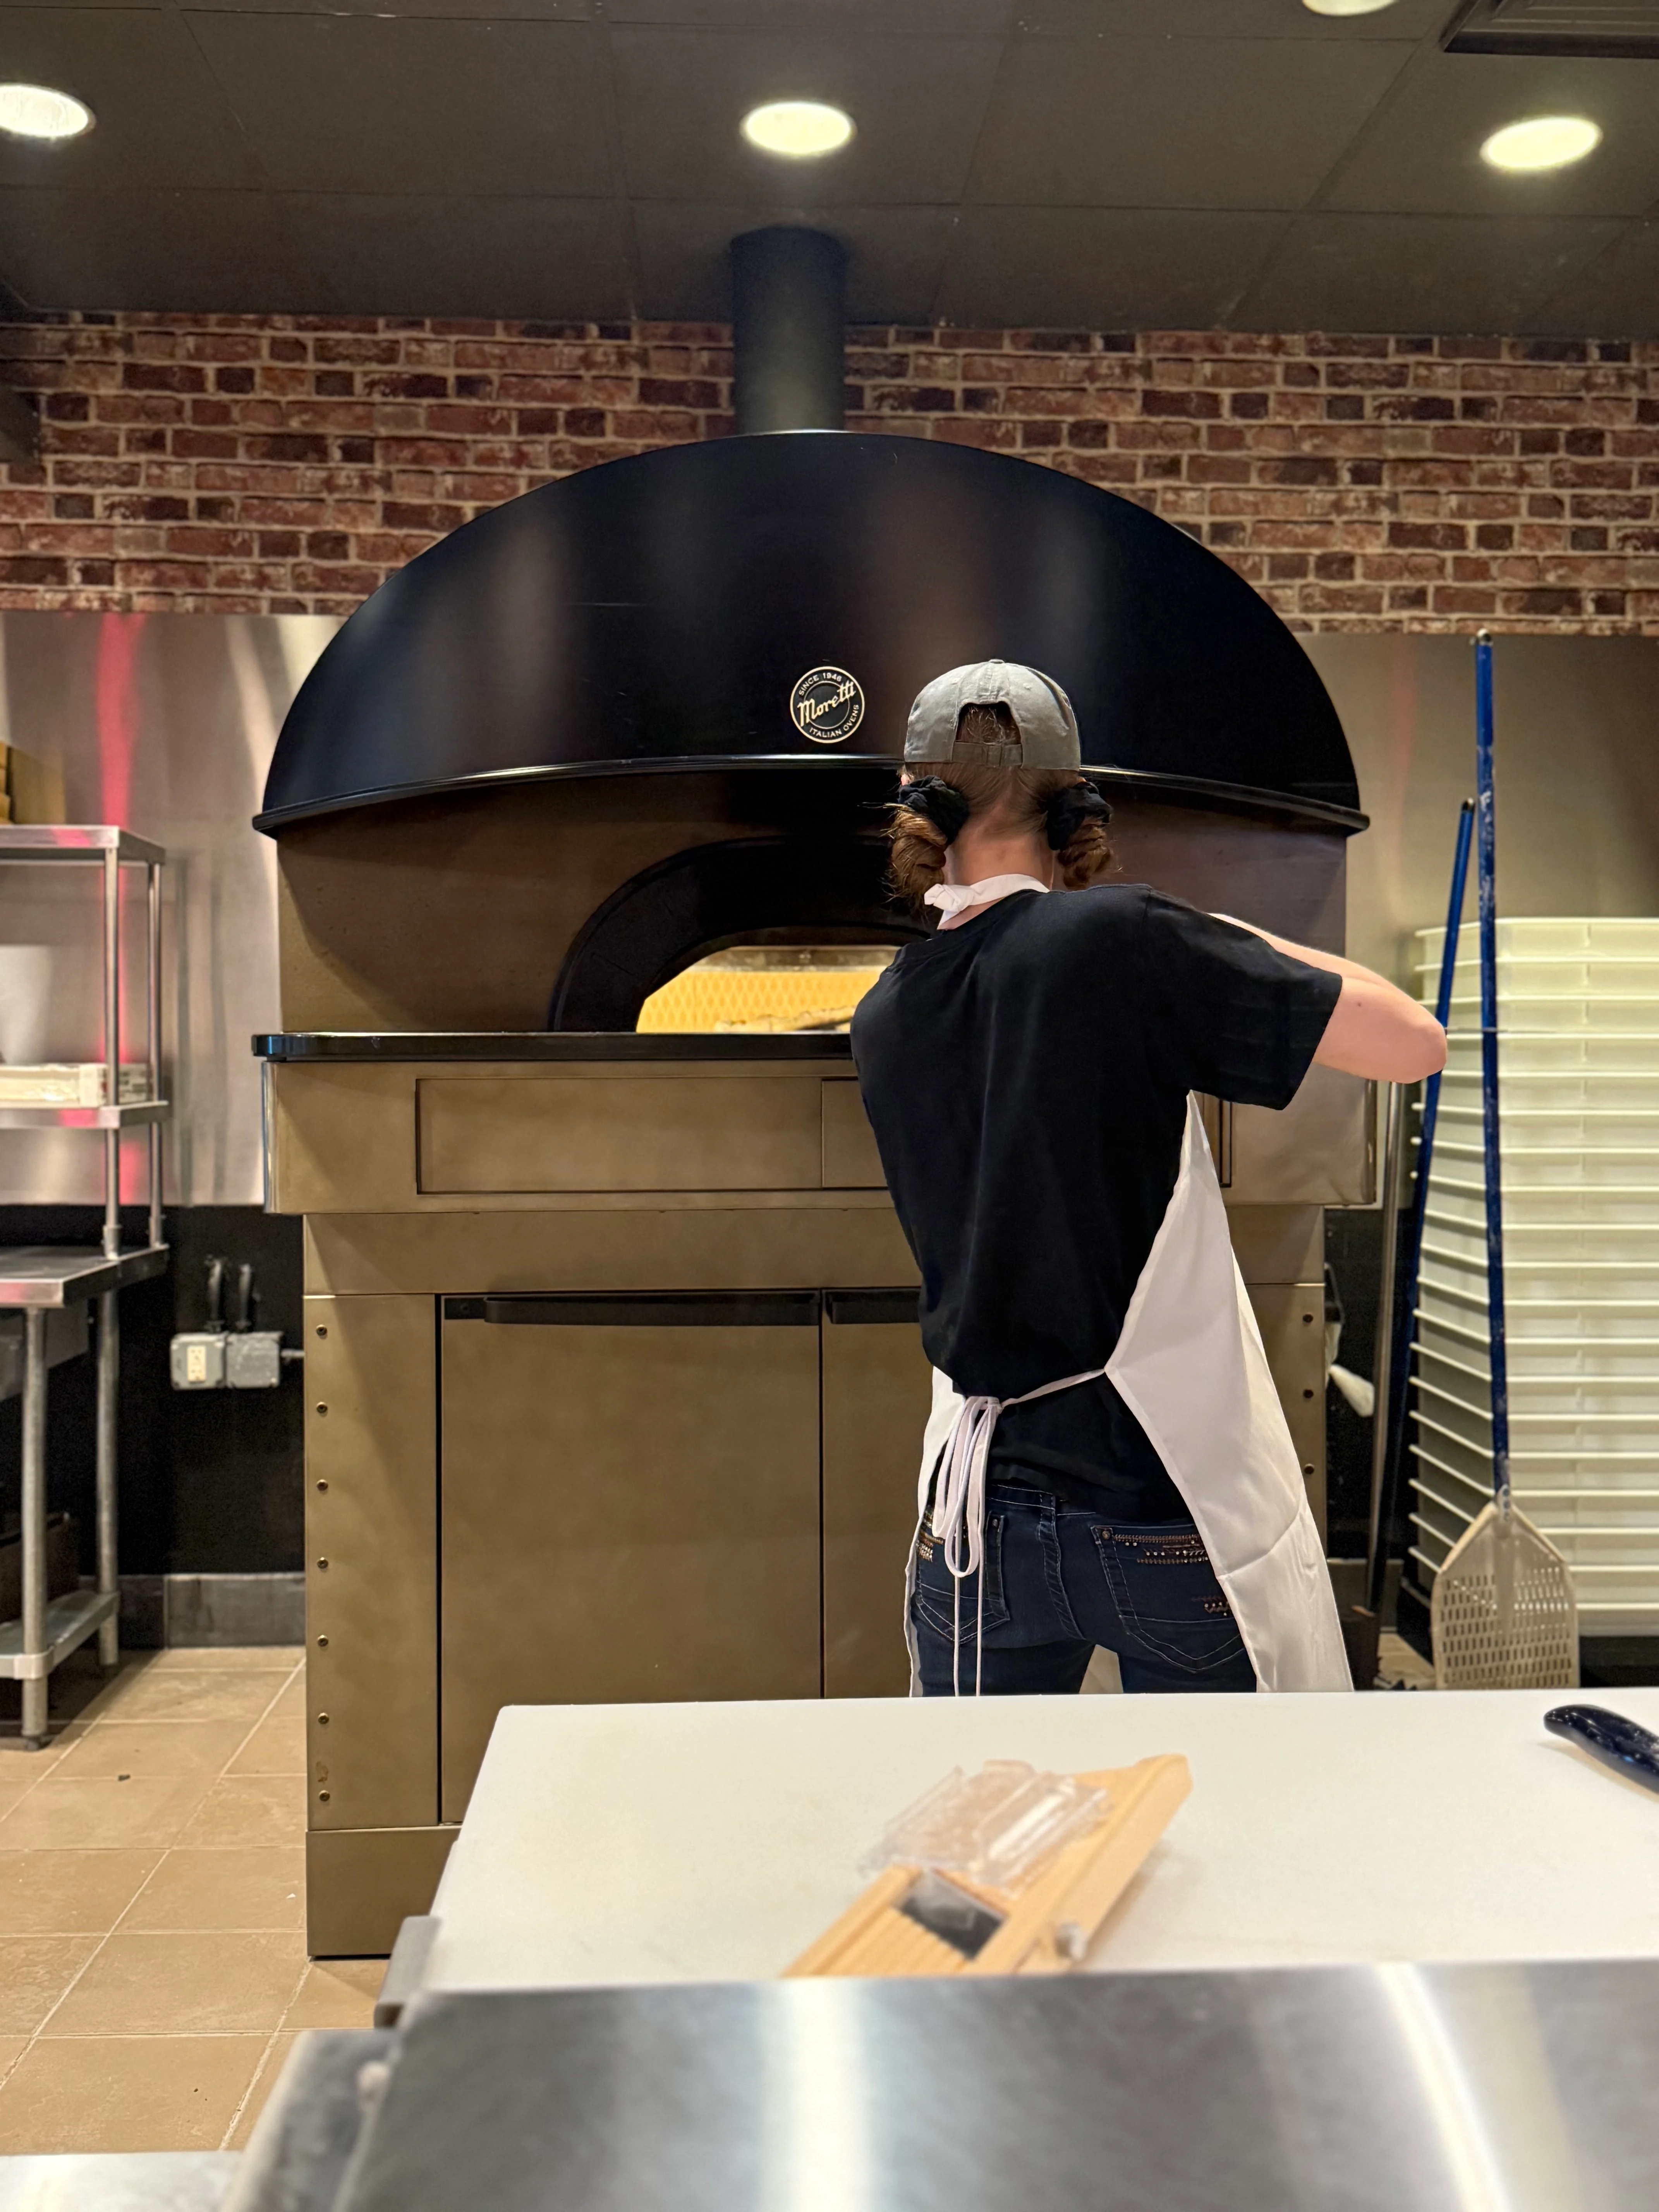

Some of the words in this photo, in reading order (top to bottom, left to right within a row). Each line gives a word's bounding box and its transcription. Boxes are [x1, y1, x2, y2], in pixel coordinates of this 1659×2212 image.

[799, 675, 819, 696] SINCE
[797, 680, 856, 727] Moretti
[809, 727, 842, 738] ITALIAN
[843, 704, 859, 731] OVENS
